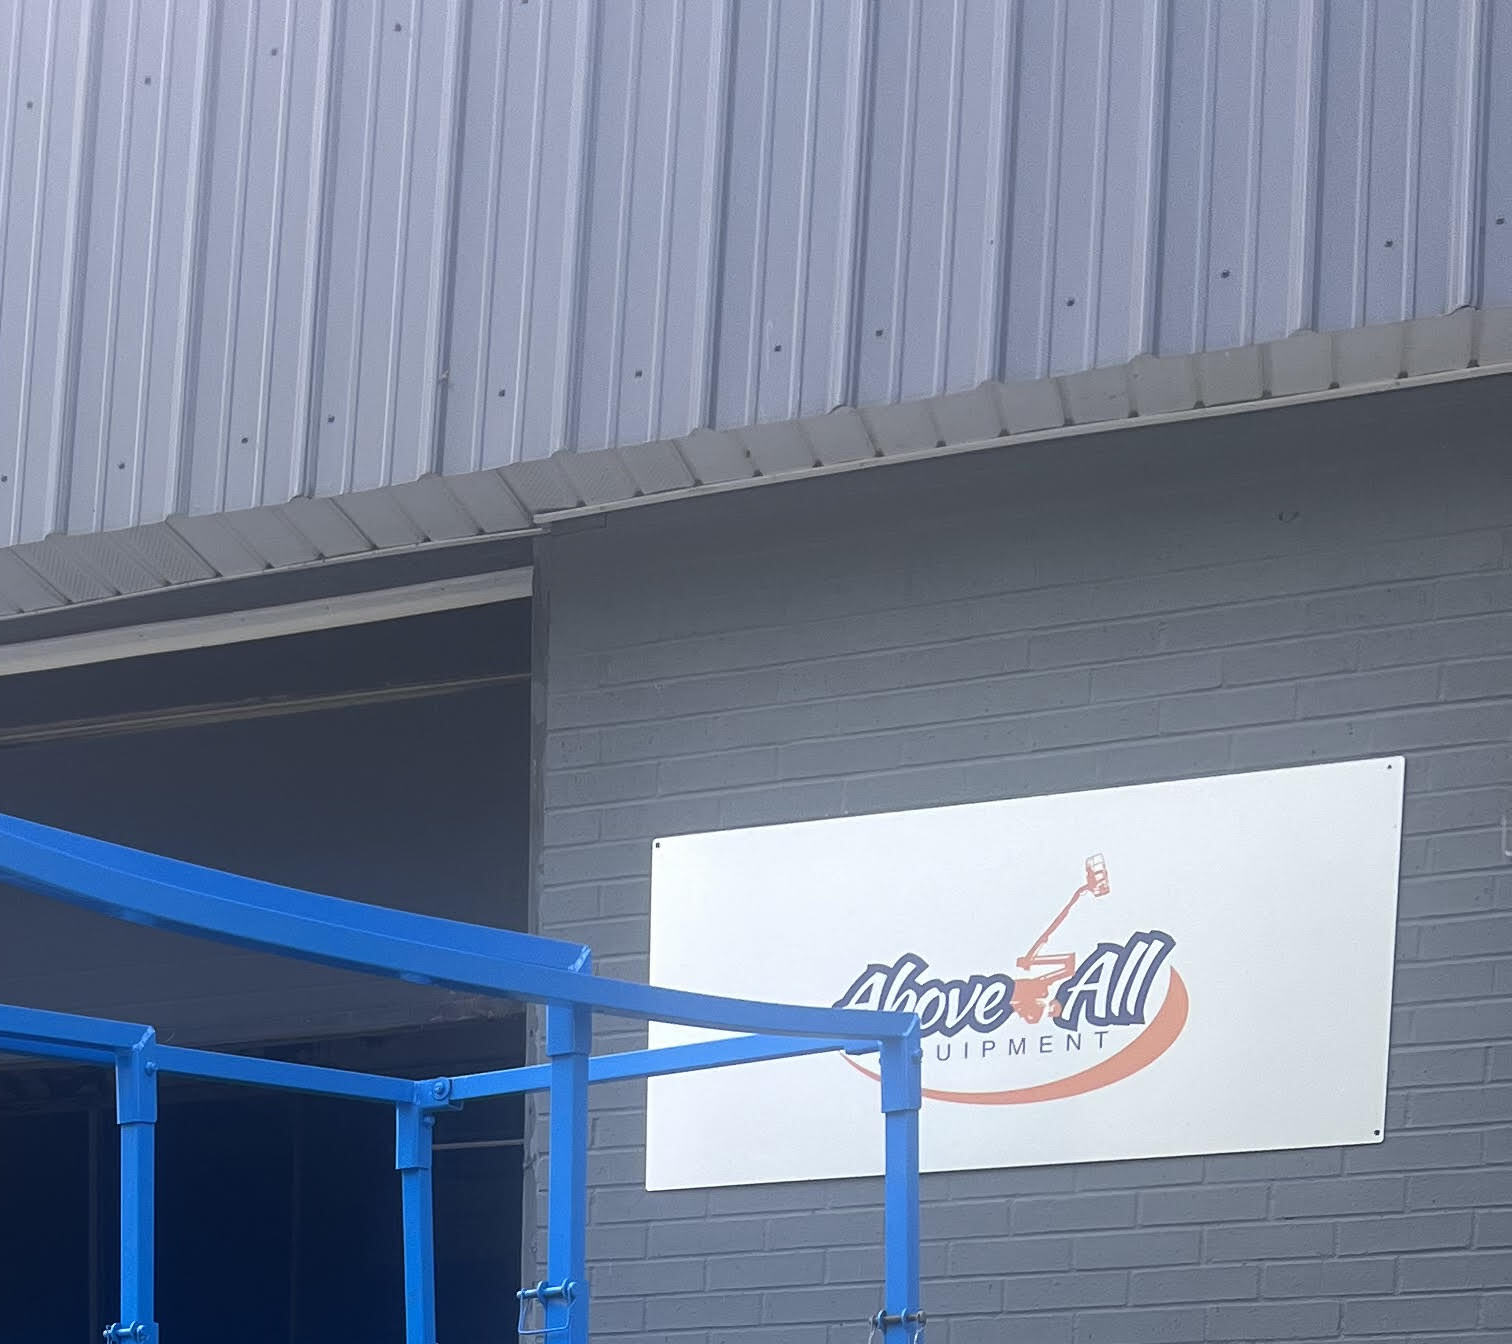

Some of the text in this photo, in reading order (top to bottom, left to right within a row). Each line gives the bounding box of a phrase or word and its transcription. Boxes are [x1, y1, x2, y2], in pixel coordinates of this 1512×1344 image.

[834, 930, 1176, 1037] Above All
[937, 1031, 1109, 1062] UIPMENT
